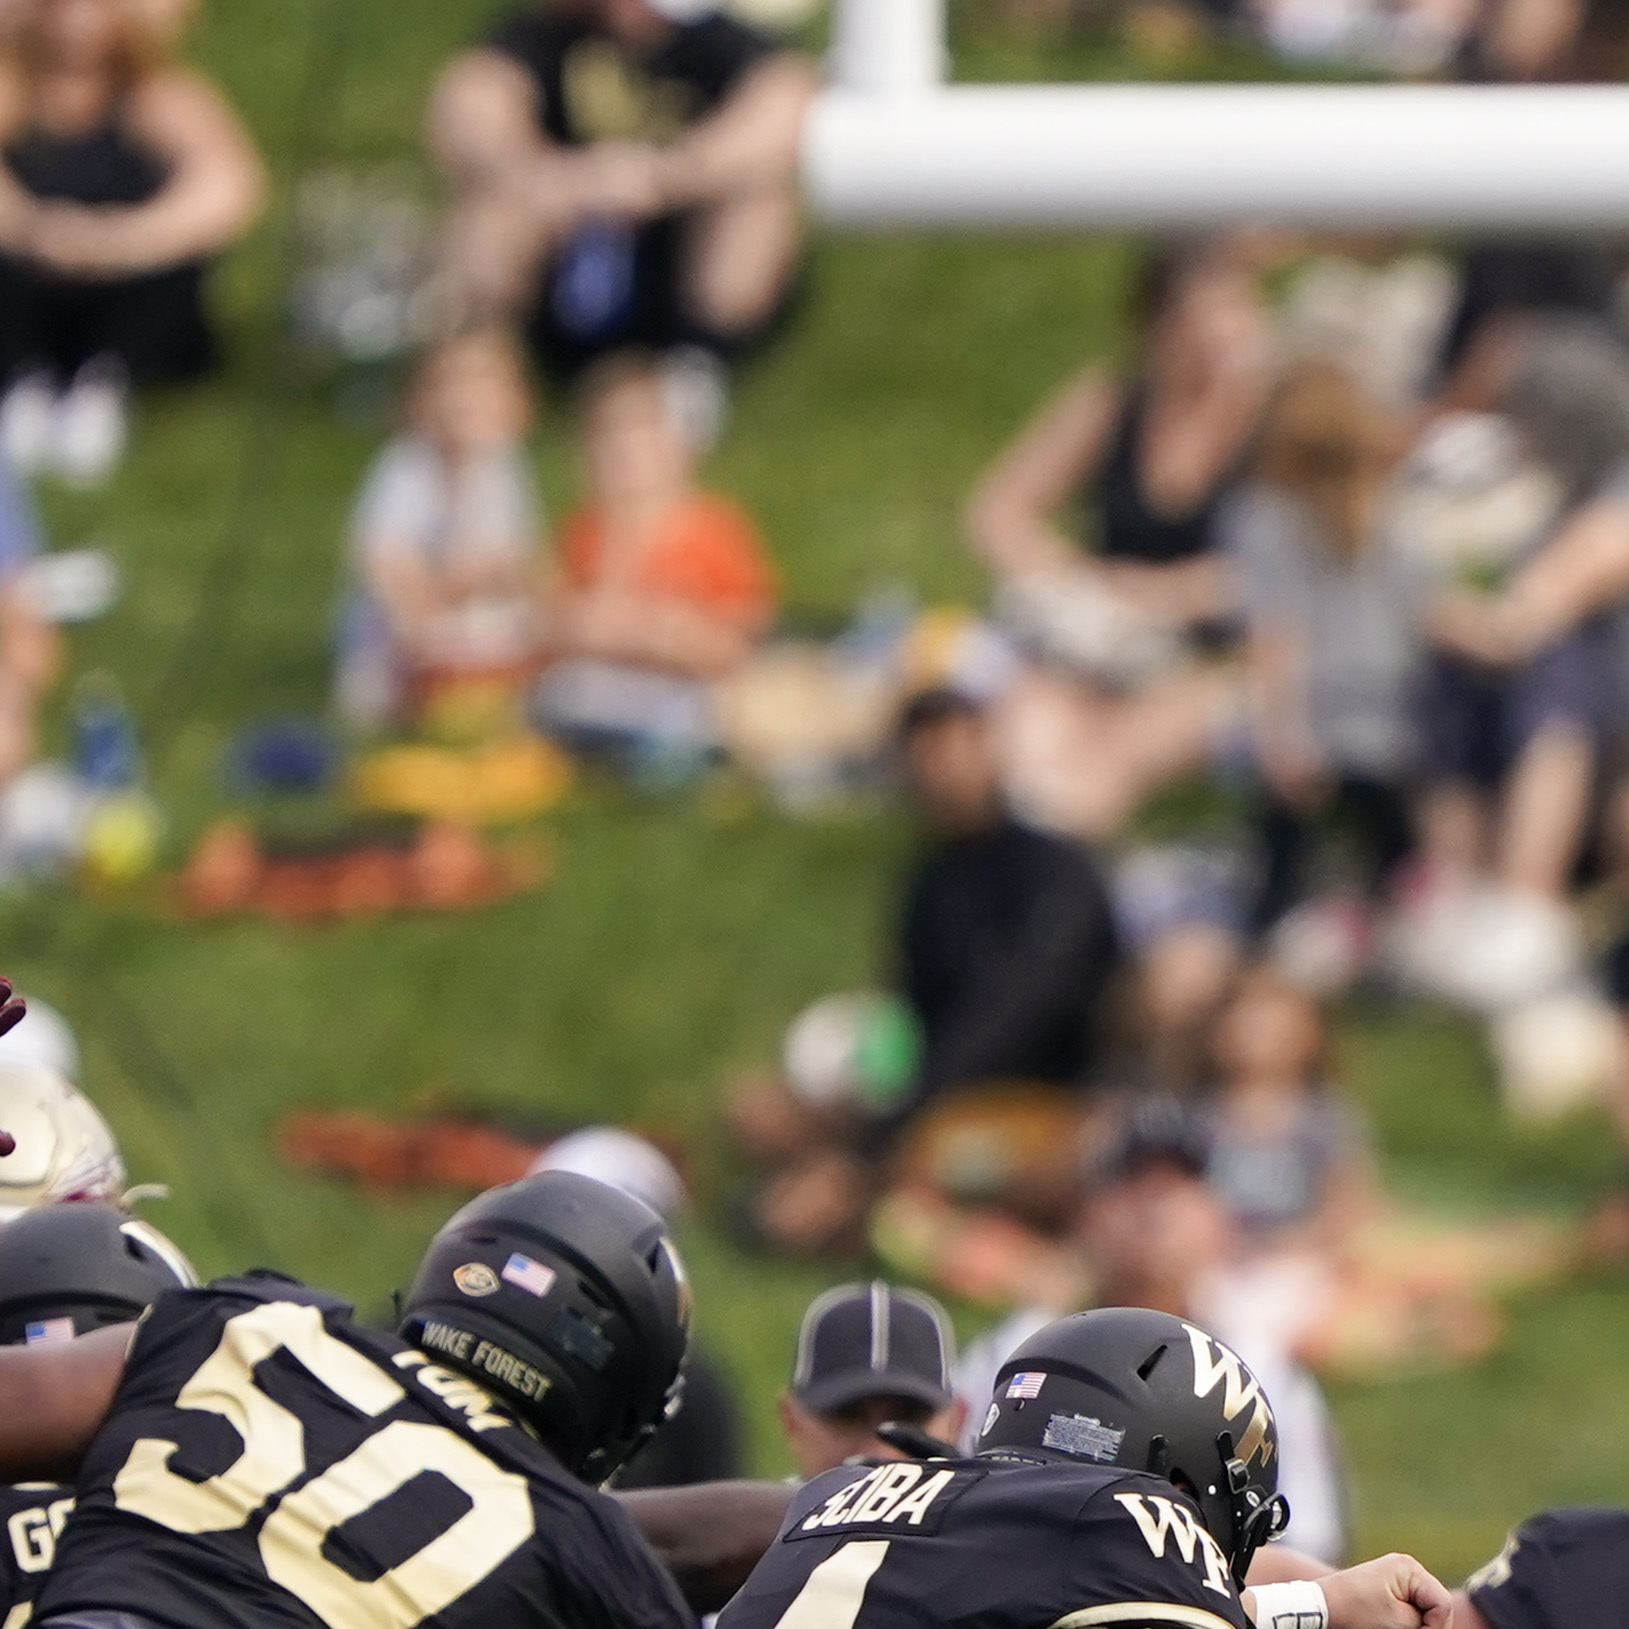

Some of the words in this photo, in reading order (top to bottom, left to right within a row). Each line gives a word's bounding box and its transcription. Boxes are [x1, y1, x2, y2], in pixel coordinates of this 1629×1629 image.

[421, 1321, 477, 1360] WAKE
[472, 1341, 553, 1401] FOREST
[1113, 1493, 1231, 1599] WF
